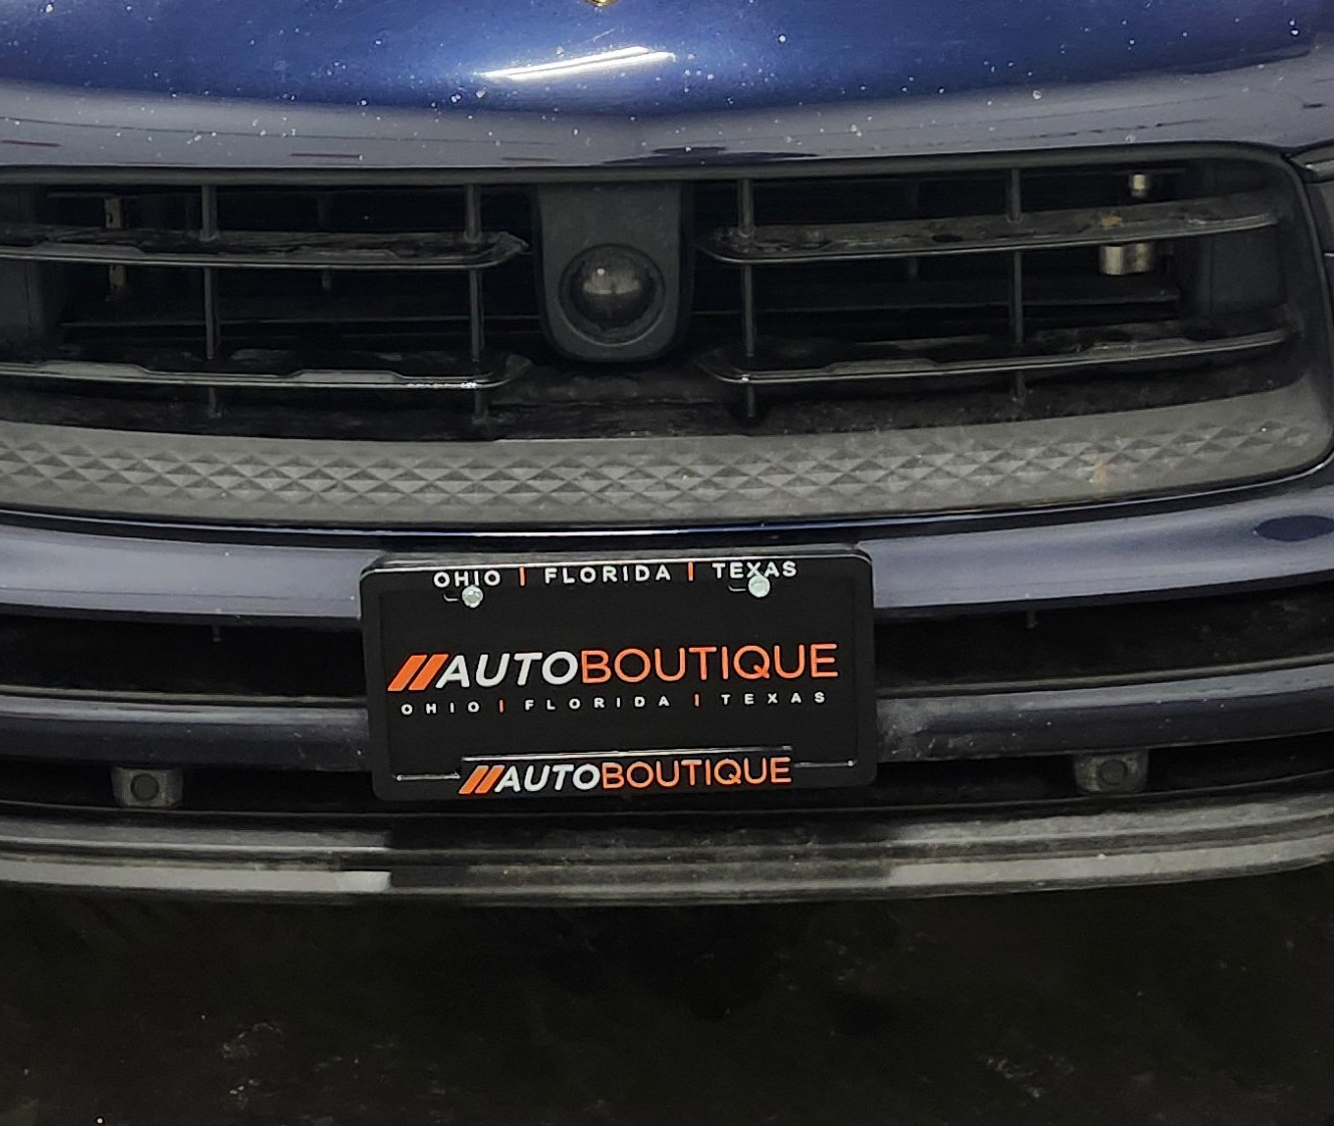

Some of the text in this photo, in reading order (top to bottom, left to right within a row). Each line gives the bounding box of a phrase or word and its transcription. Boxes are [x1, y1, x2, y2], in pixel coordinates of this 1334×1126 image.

[433, 560, 797, 588] OHIO FLORIDA TEXAS
[434, 643, 839, 689] AUTOBOUTIQUE
[400, 691, 827, 716] OHIO FLORIDA TEXAS
[494, 757, 793, 794] AUTOBOUTIQUE
